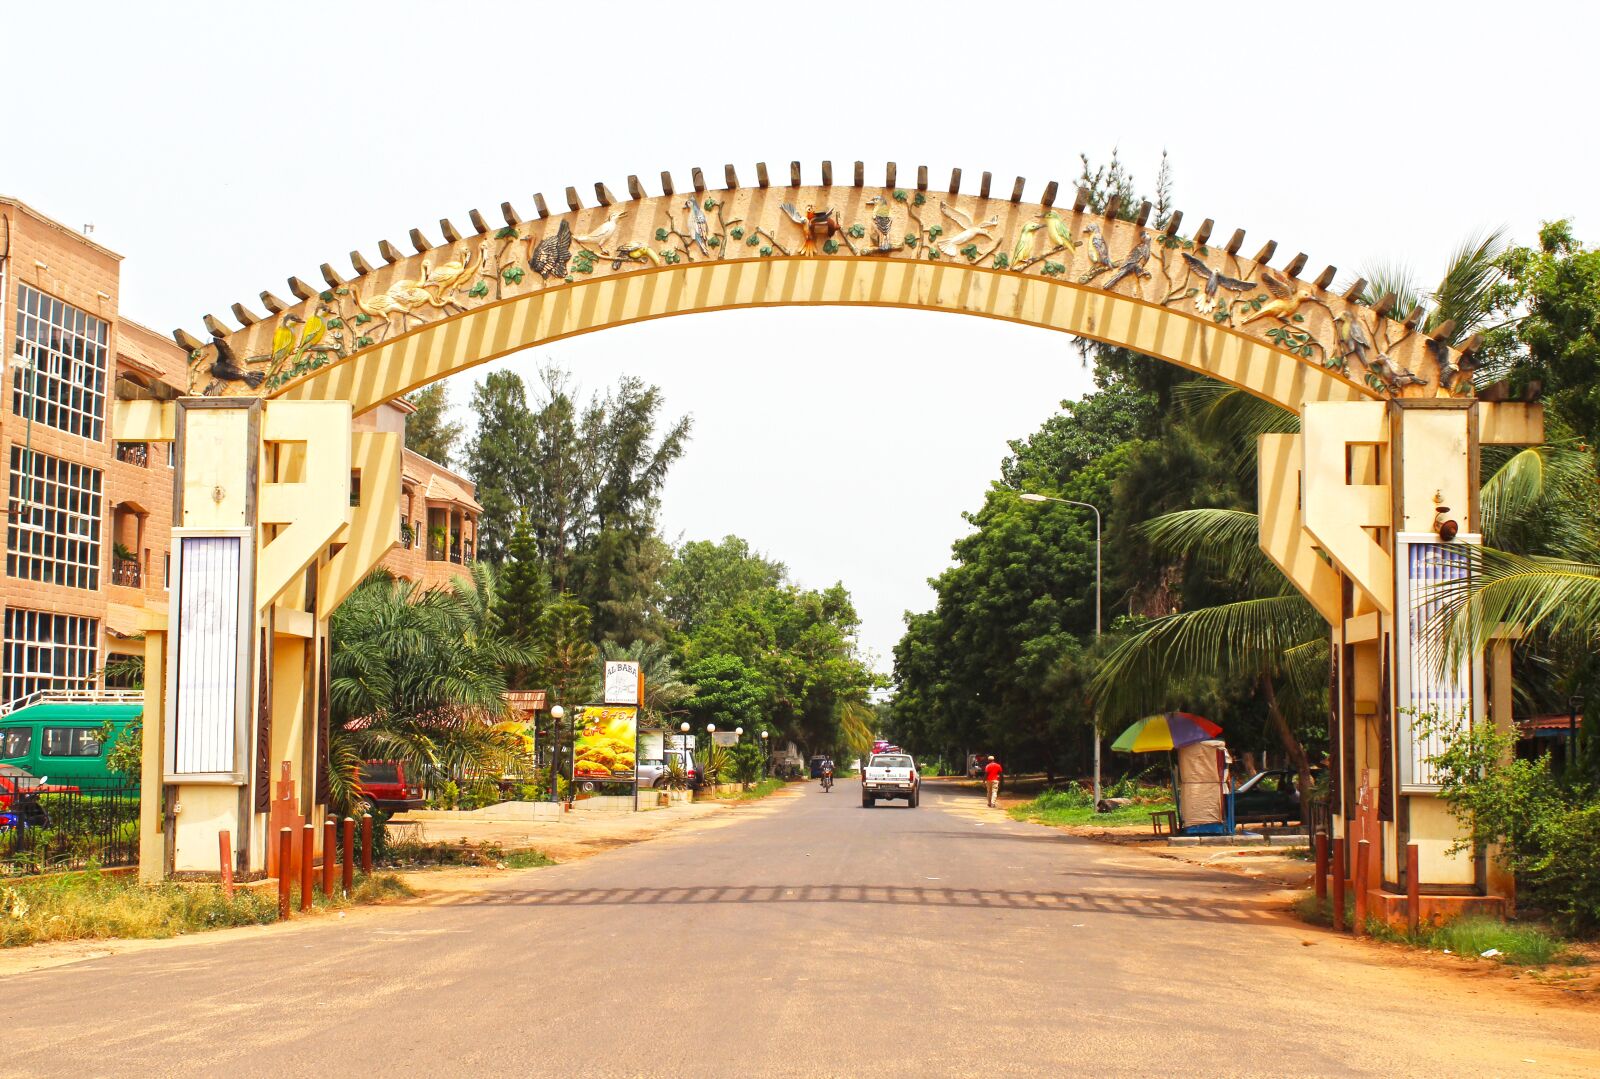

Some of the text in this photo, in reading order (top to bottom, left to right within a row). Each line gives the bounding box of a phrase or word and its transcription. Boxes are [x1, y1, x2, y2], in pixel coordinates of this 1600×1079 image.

[606, 663, 637, 678] AL BABA
[601, 710, 635, 720] BABA
